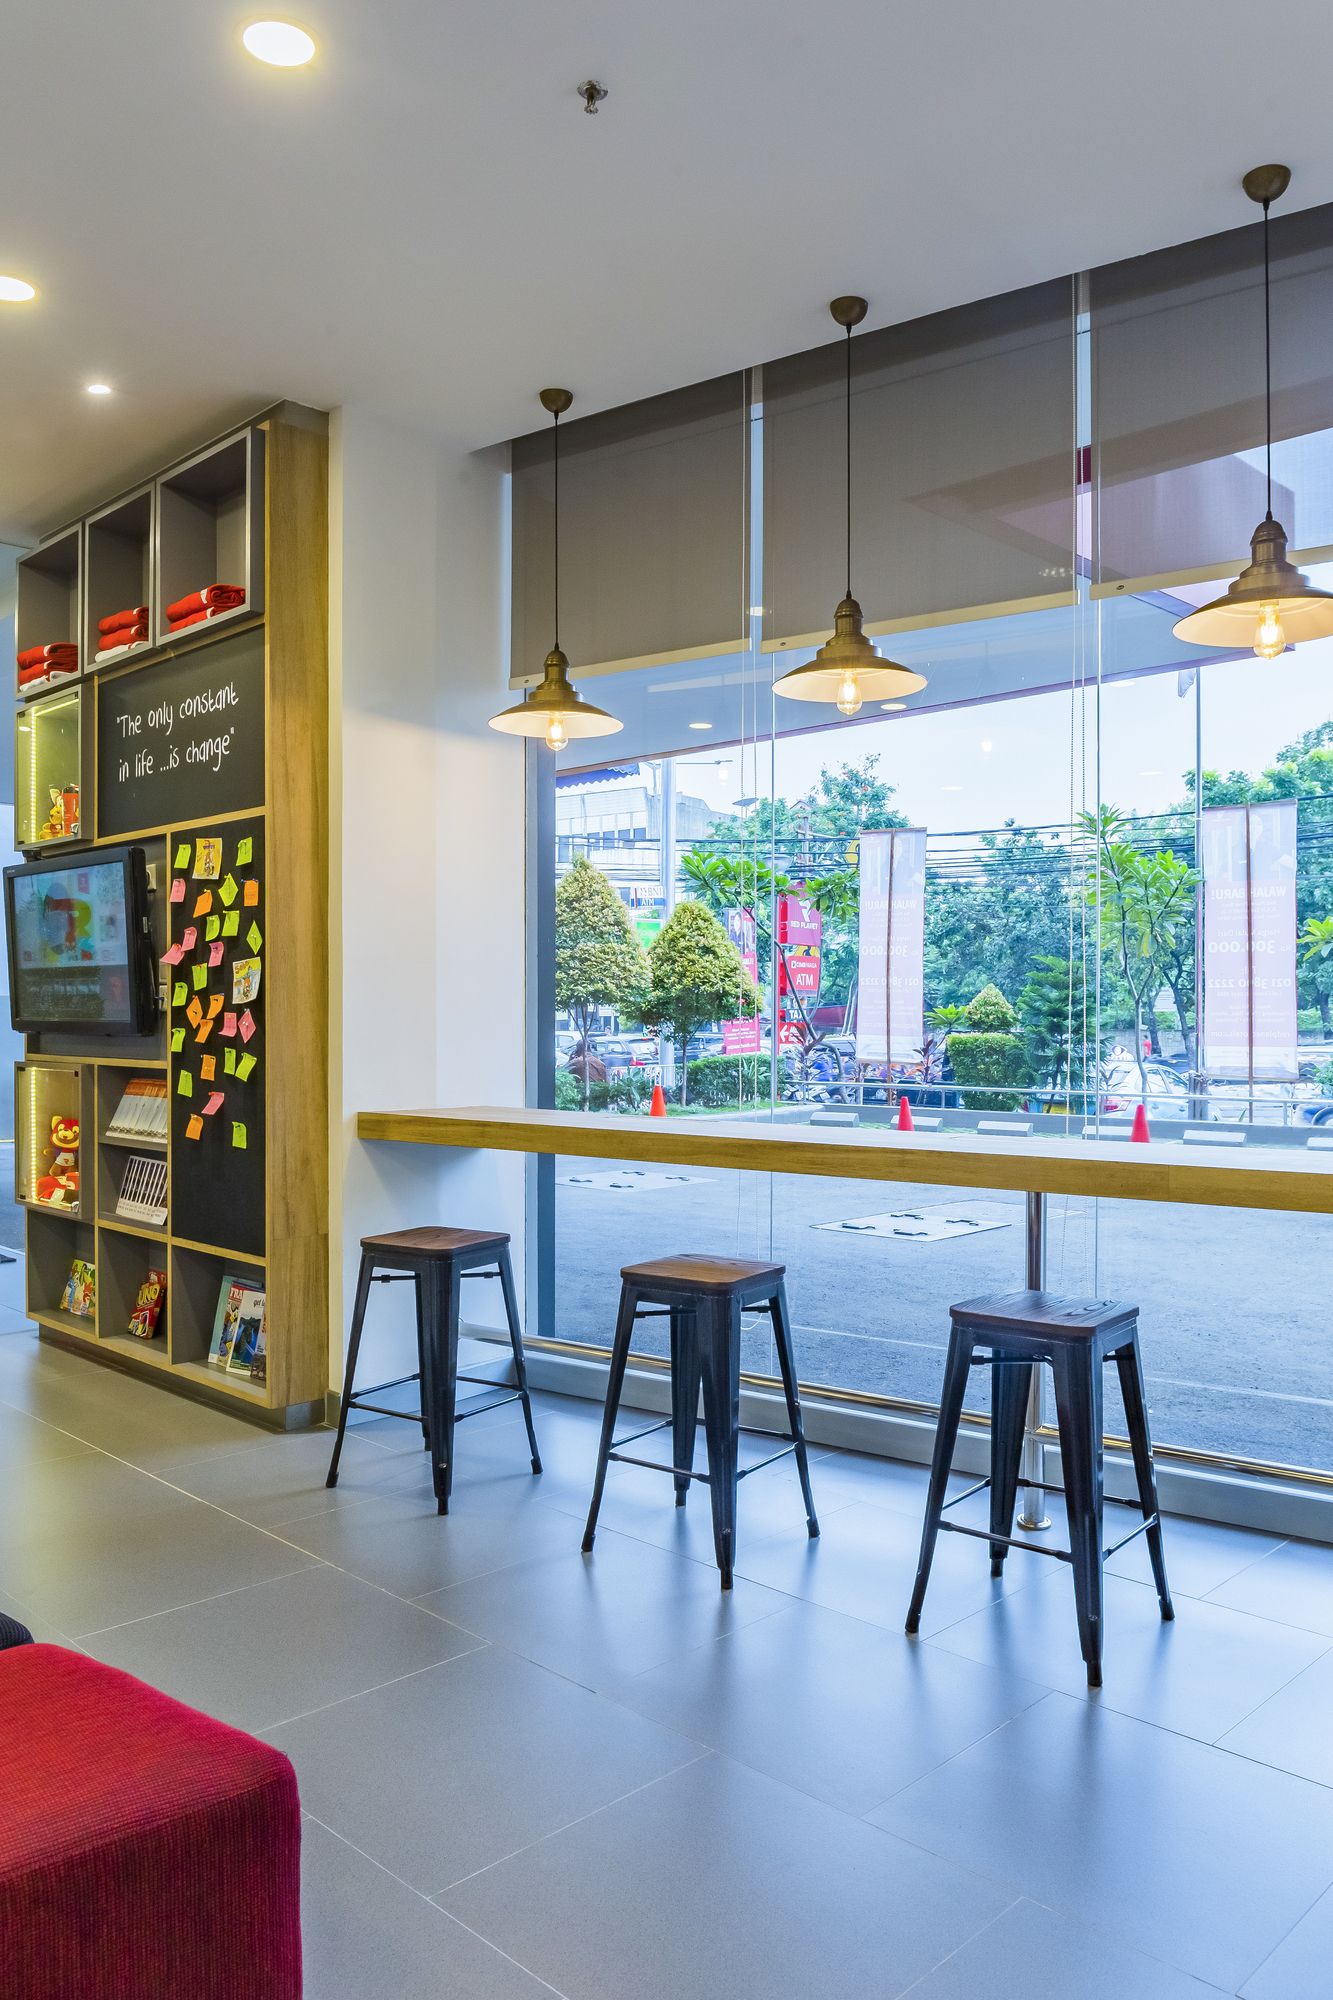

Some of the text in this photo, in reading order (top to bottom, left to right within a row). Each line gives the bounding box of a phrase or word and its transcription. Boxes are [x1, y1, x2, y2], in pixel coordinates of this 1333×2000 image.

[117, 682, 239, 738] "The only constant
[119, 759, 129, 782] in
[135, 748, 154, 778] life
[641, 898, 655, 906] ATM
[801, 922, 818, 930] PLANET
[796, 973, 814, 986] ATM
[136, 1282, 160, 1307] UNO
